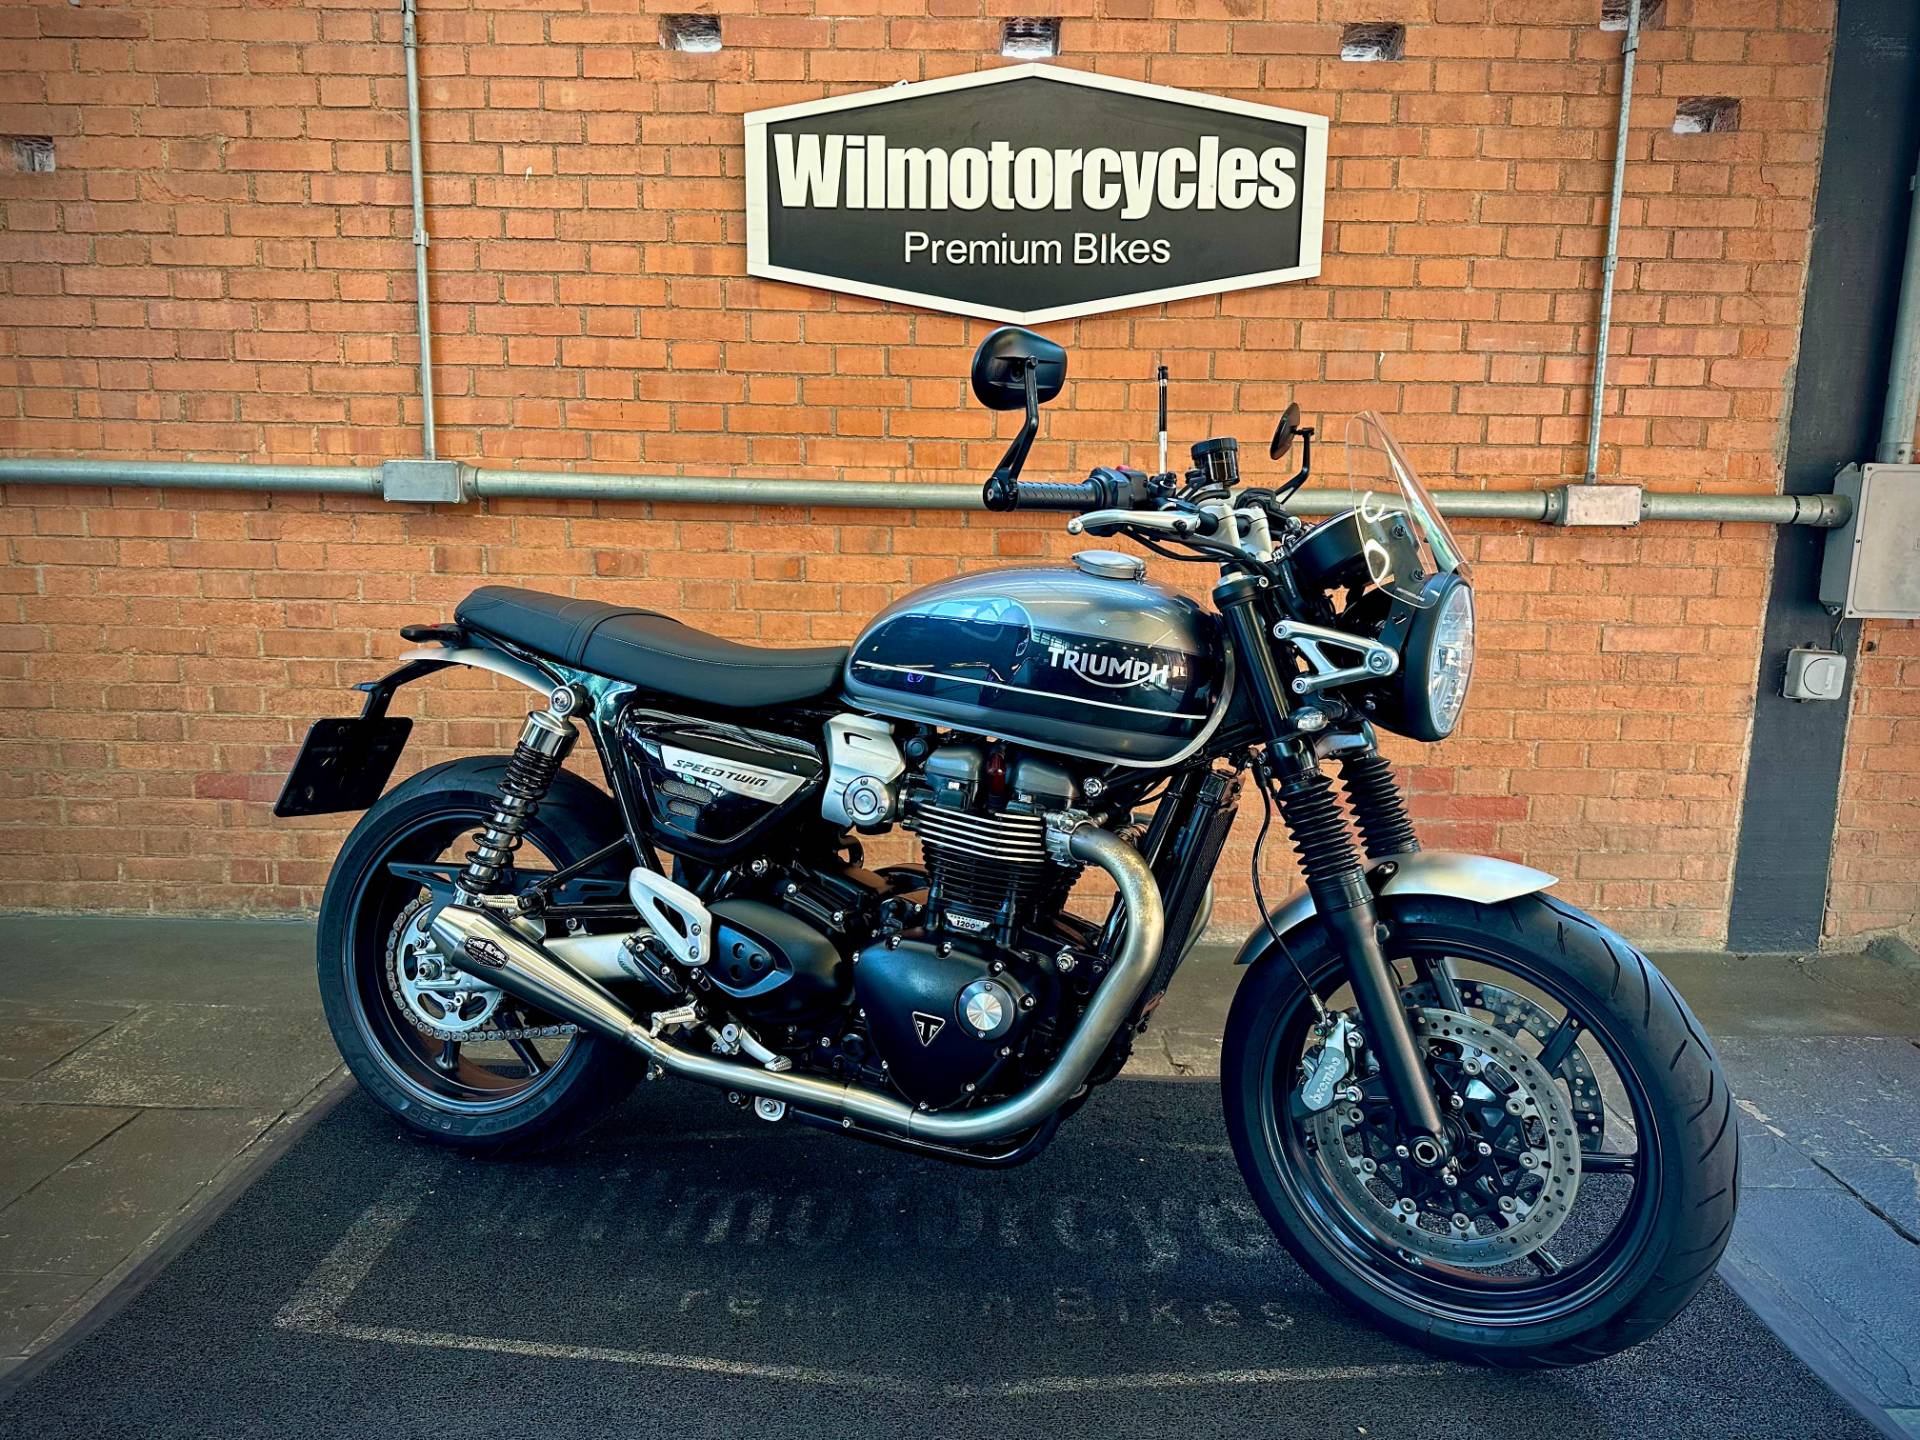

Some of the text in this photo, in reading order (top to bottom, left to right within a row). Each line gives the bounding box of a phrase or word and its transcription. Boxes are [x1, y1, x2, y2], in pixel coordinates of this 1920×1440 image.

[773, 133, 1297, 220] Wilmotorcycles
[904, 231, 1063, 265] Premium
[1048, 647, 1169, 688] TRIUMPH
[672, 759, 726, 777] SPEED
[1309, 1056, 1342, 1105] brembo
